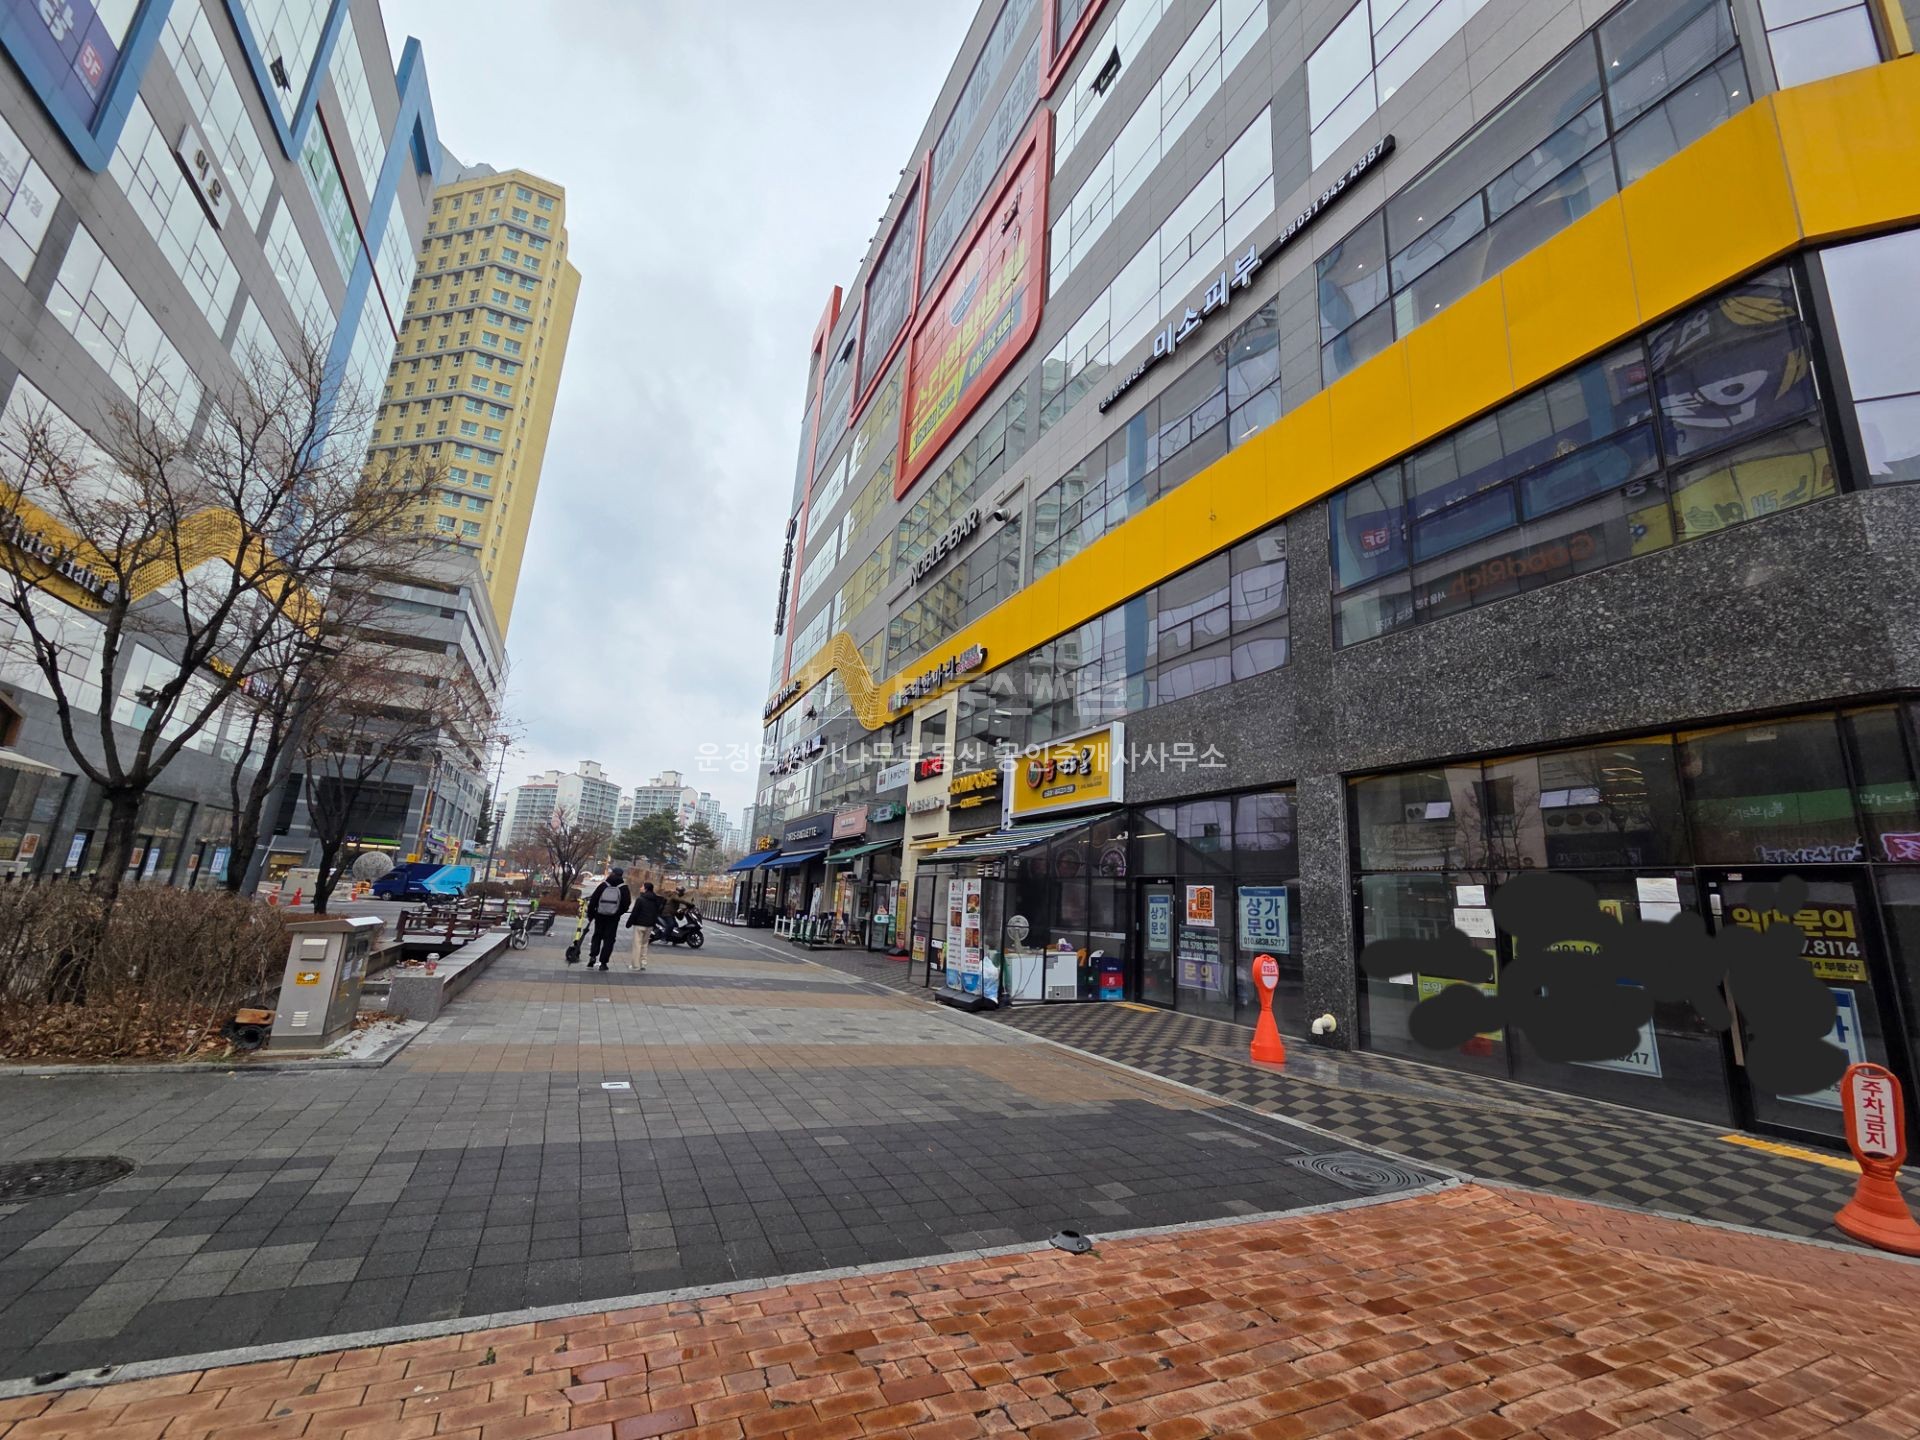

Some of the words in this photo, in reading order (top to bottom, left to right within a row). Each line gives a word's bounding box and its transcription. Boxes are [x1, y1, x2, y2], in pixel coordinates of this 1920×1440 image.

[82, 44, 101, 77] 5F
[1297, 200, 1320, 227] 031
[1322, 175, 1346, 206] 945
[1350, 139, 1385, 179] 4887
[1153, 243, 1262, 358] 미소피부
[910, 534, 948, 587] NOBLE
[949, 508, 979, 550] BAR
[902, 655, 956, 706] 동태한마리
[950, 768, 998, 796] COMPOSE
[1150, 906, 1168, 921] 상가
[1246, 897, 1281, 917] 상가
[1150, 921, 1168, 936] 문의
[1247, 917, 1281, 938] 문의
[1184, 961, 1213, 984] 문의
[1824, 961, 1860, 973] 부동산
[1861, 1080, 1887, 1150] 주차금지
